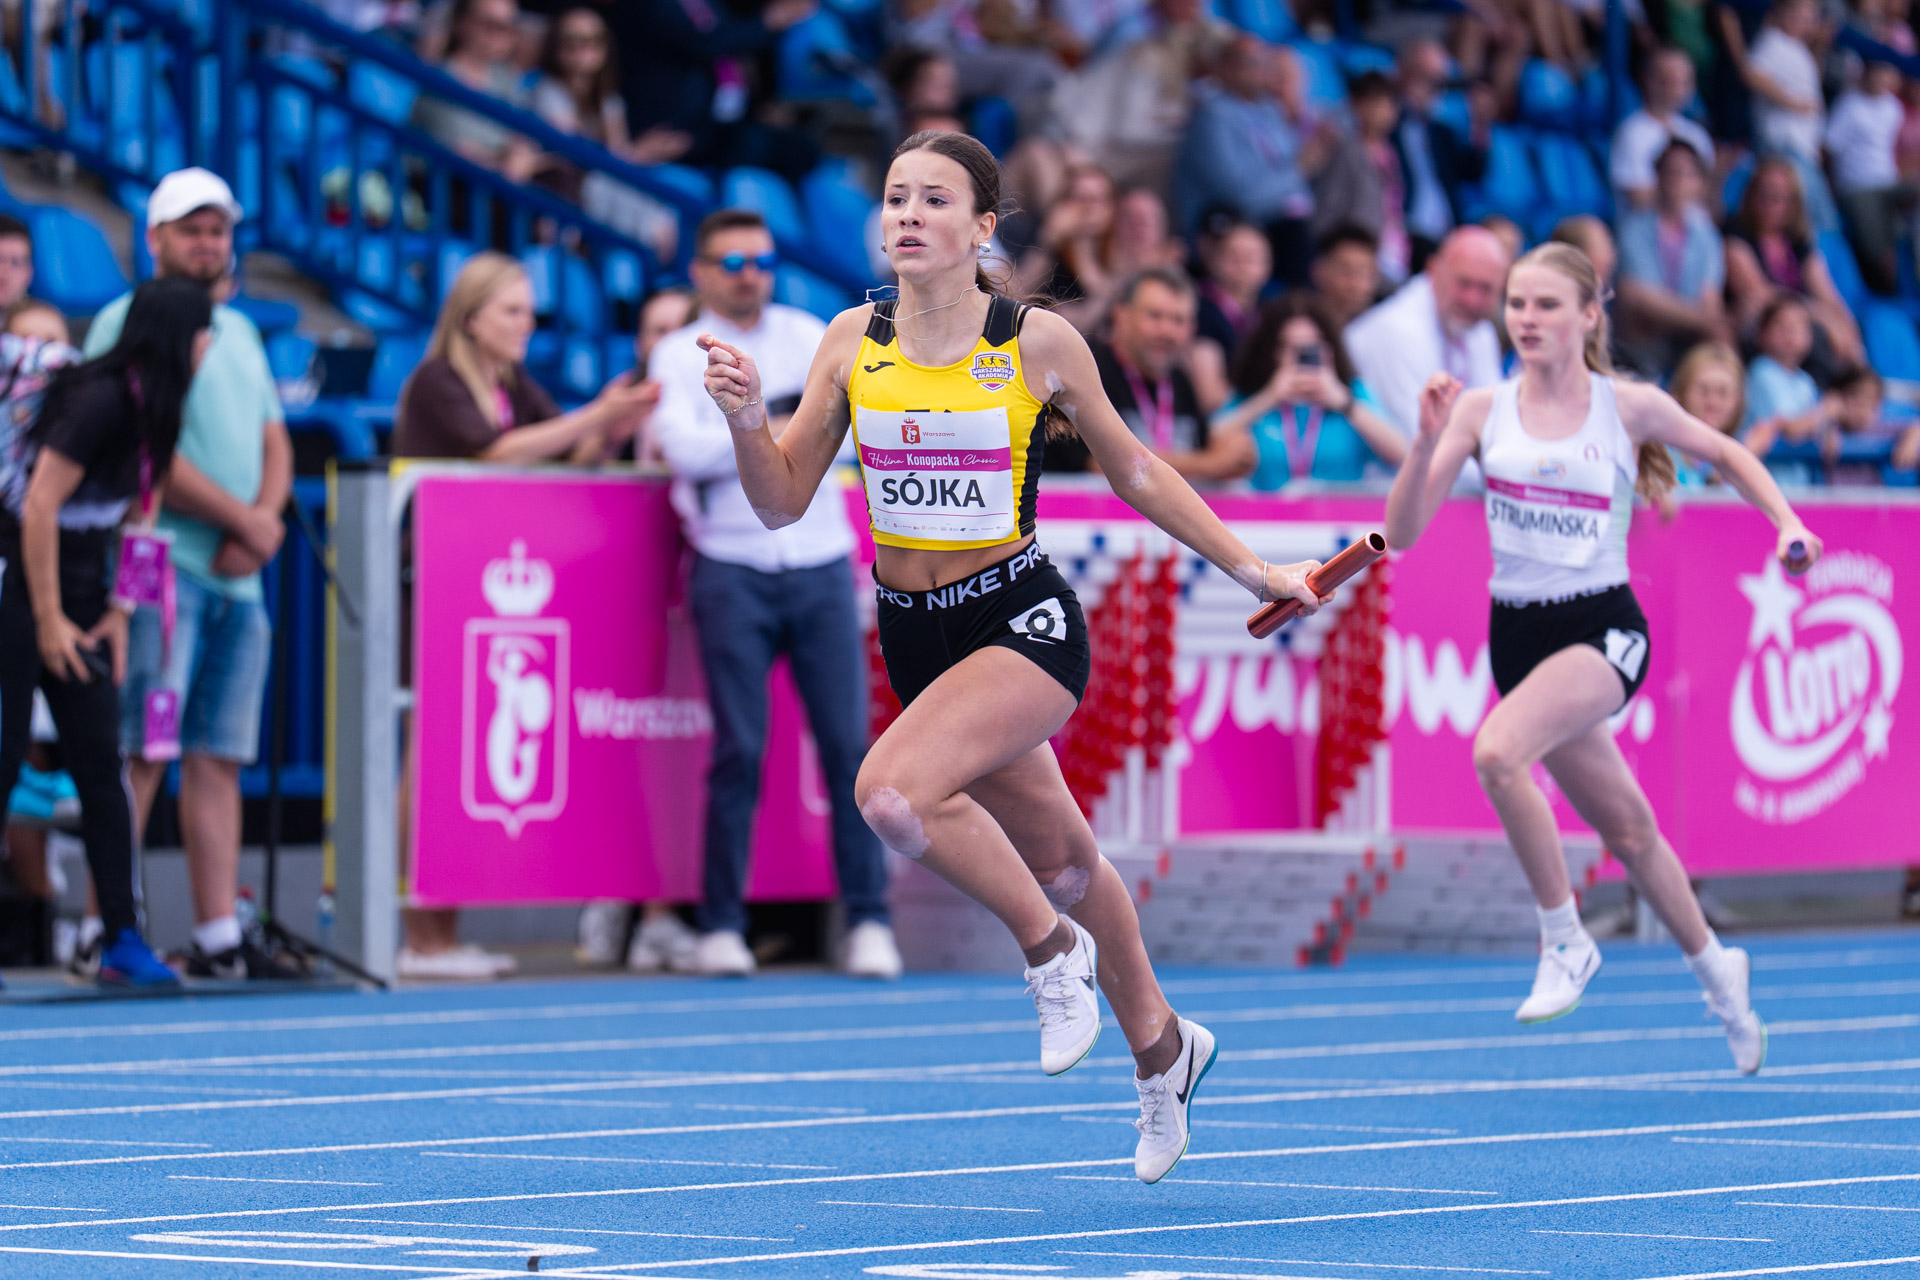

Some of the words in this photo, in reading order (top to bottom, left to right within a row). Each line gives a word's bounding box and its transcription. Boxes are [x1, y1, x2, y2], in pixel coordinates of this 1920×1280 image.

[868, 452, 904, 467] Halina
[906, 453, 959, 468] Konopacka
[962, 454, 999, 466] Classic
[881, 472, 986, 507] SÓJKA
[1489, 498, 1599, 539] STRUMIŃSKA
[926, 567, 1002, 611] NIKE
[1762, 631, 1872, 741] LOTTO
